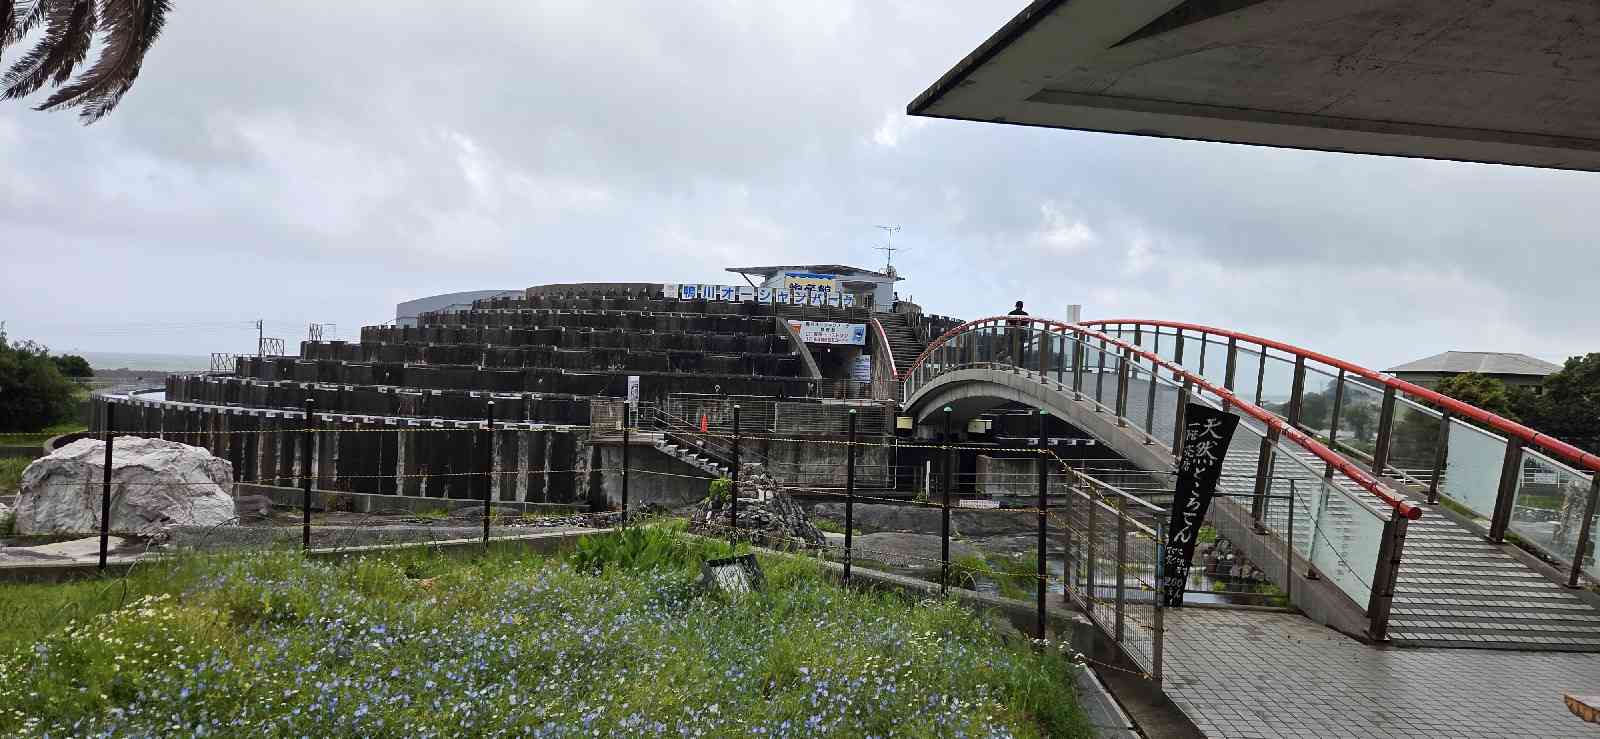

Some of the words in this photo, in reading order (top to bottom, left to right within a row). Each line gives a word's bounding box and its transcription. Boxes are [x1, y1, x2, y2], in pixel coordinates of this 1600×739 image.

[1174, 418, 1225, 543] 天然ところてん
